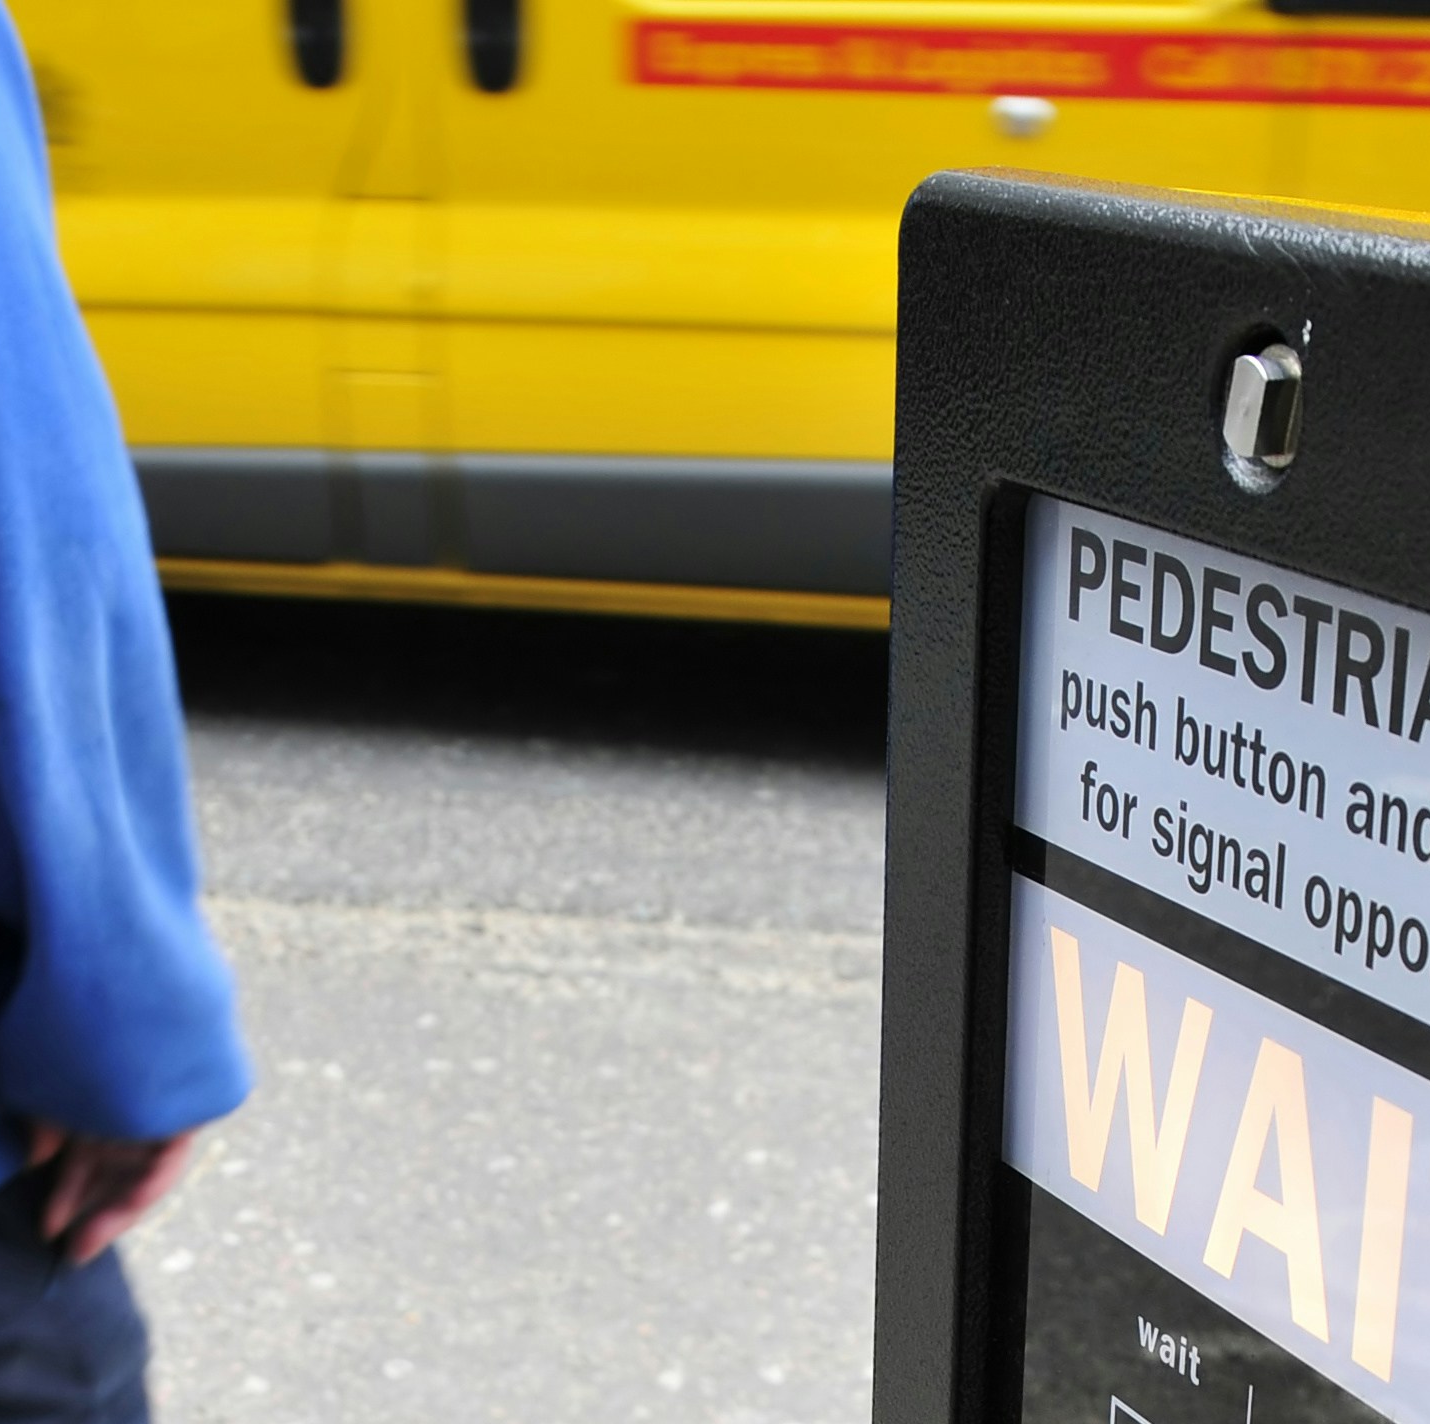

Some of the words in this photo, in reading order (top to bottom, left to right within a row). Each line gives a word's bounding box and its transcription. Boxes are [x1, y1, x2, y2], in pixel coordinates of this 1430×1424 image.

[1061, 669, 1158, 751] push
[1175, 697, 1326, 819] button
[1080, 760, 1137, 840] for
[1152, 803, 1286, 910] signal
[1138, 1315, 1201, 1386] wait
